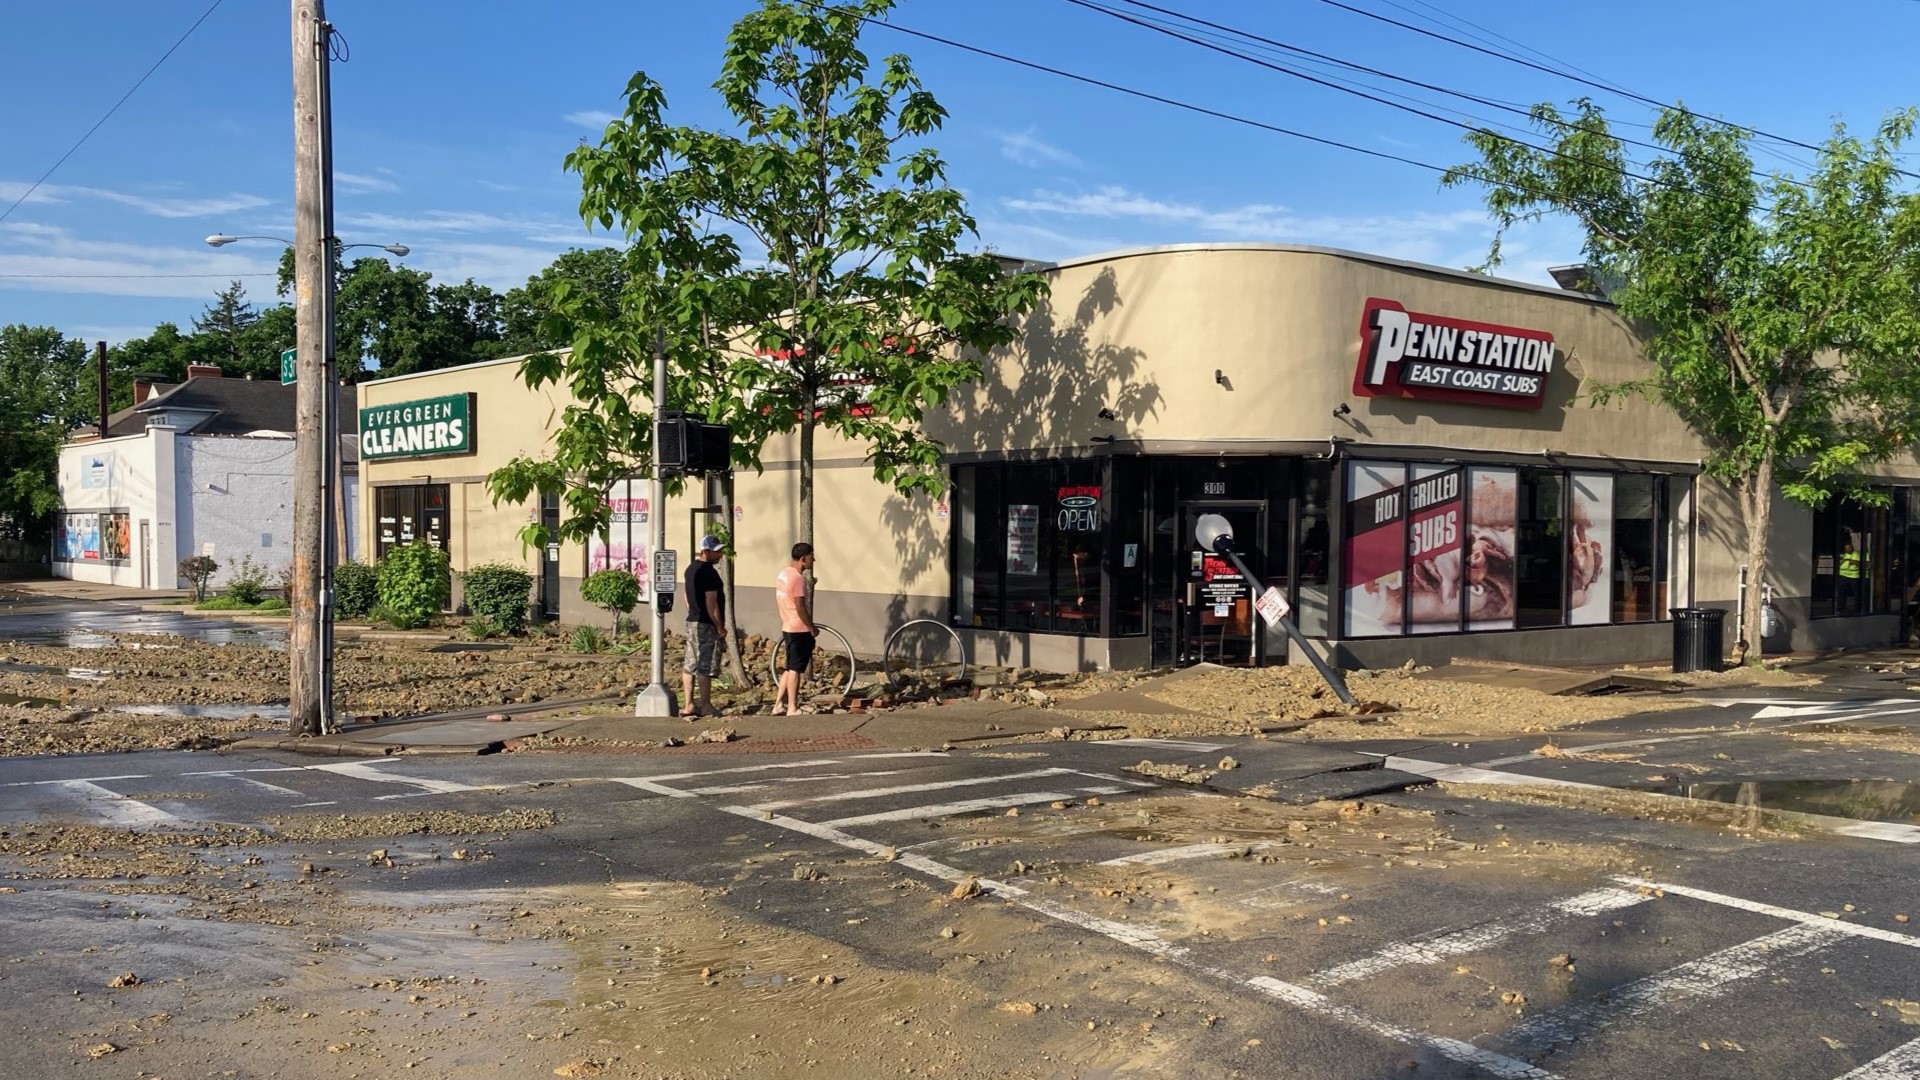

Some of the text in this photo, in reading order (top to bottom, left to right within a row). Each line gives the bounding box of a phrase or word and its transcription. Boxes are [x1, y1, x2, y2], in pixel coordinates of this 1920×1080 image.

[1371, 309, 1555, 385] PENN STATION
[1410, 364, 1538, 394] EAST COAST SUBS
[368, 402, 452, 427] EVERGREEN
[362, 418, 464, 456] CLEANERS
[1205, 483, 1224, 493] 300
[1375, 473, 1458, 524] HOT GRILLED
[1057, 509, 1097, 531] OPEN
[1409, 510, 1457, 557] SUBS
[1128, 547, 1135, 558] A
